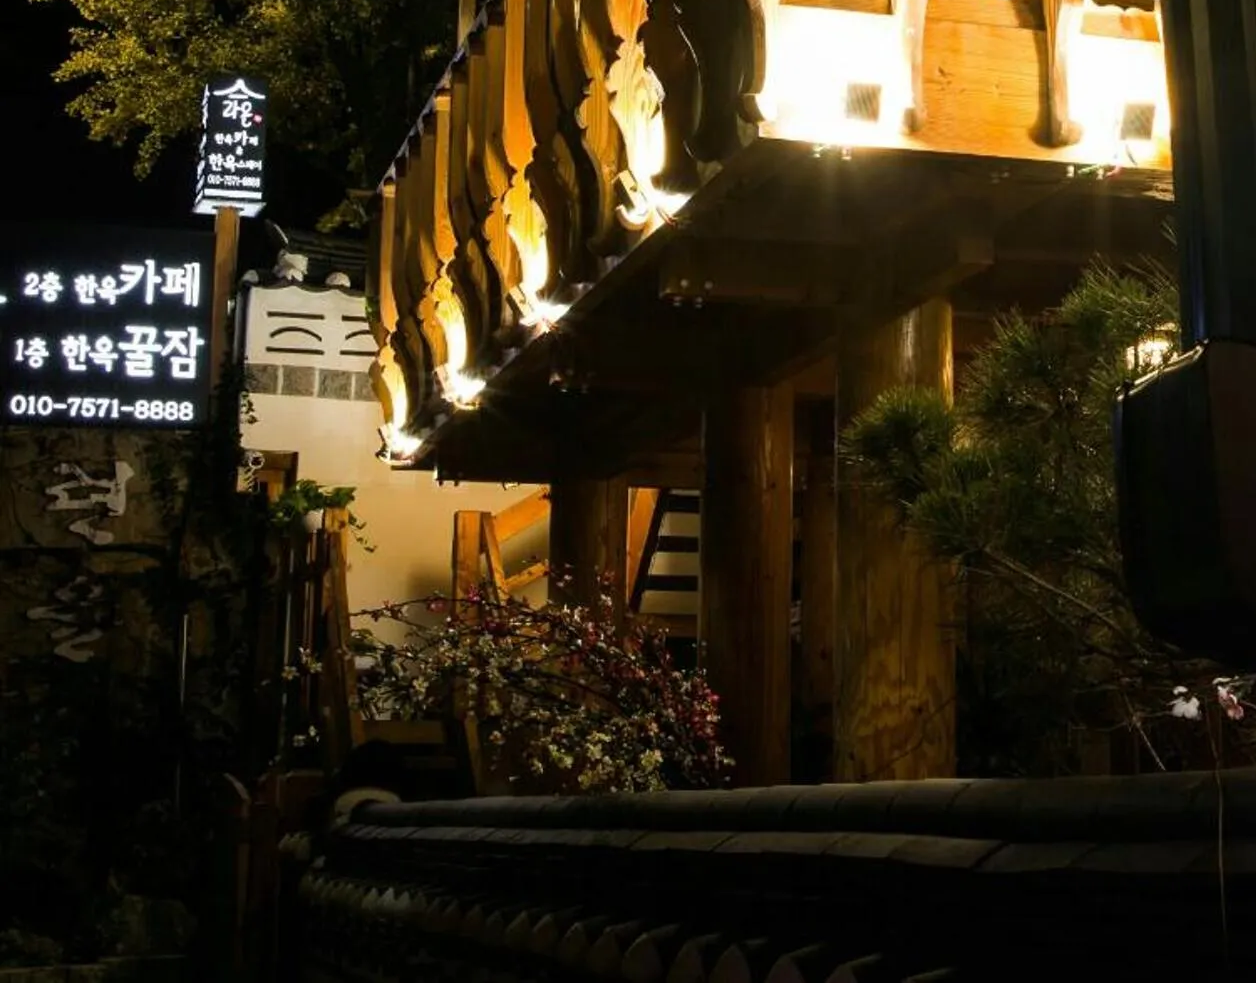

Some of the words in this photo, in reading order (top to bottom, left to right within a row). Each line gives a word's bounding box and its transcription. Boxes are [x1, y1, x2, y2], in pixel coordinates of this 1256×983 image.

[24, 271, 63, 302] 2층
[15, 337, 49, 369] 1층
[10, 395, 194, 421] 010-7571-8888
